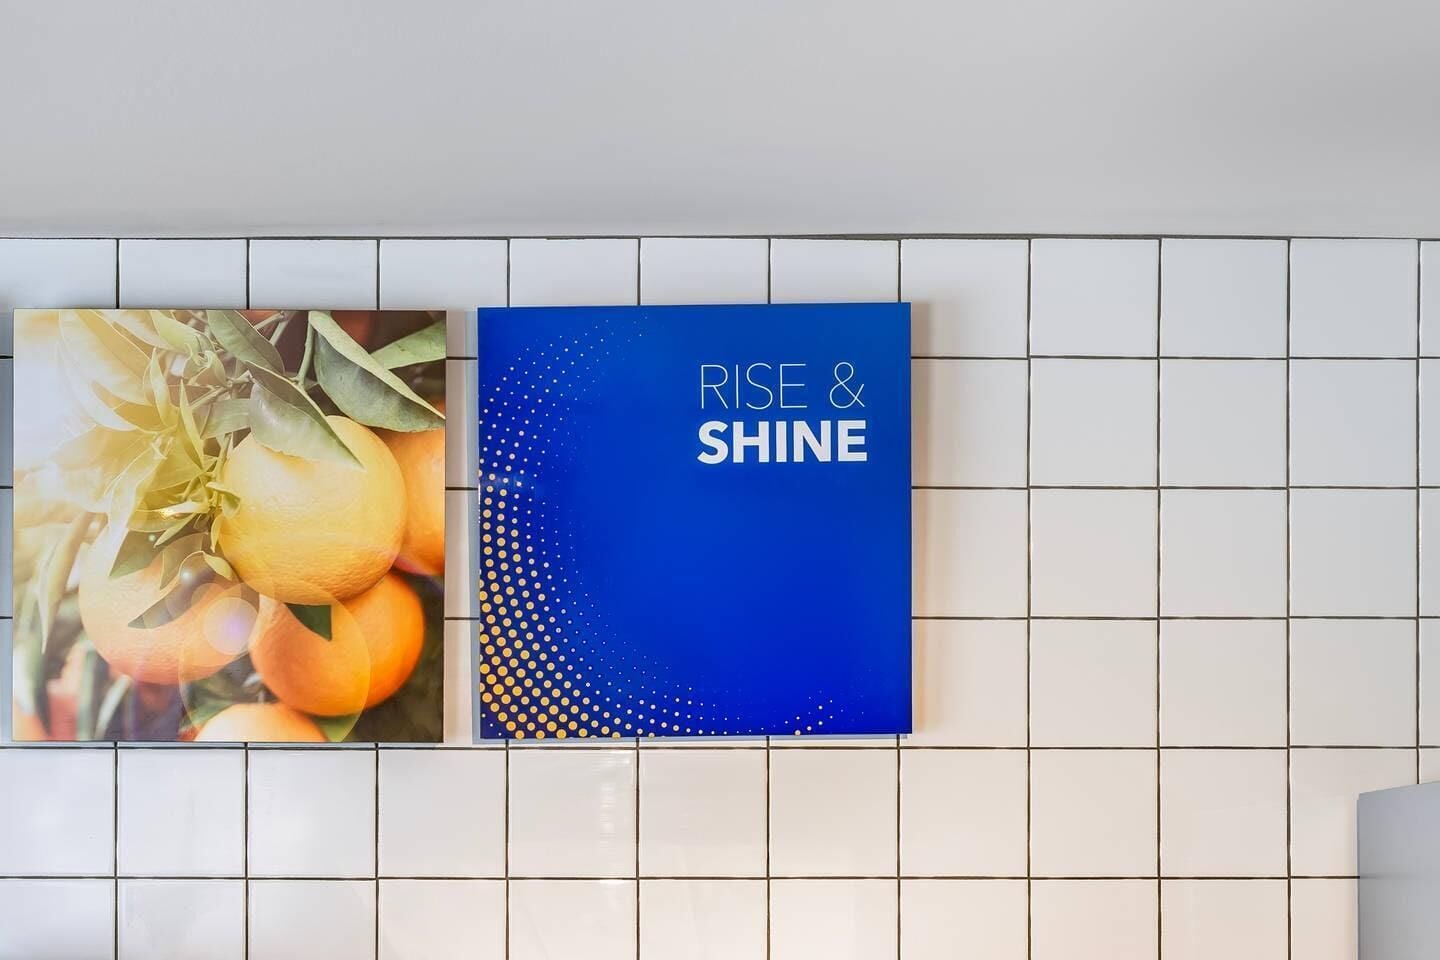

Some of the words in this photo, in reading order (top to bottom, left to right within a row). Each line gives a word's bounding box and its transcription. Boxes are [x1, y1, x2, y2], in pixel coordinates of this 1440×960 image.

[700, 362, 808, 410] RISE
[829, 361, 865, 409] &
[697, 419, 868, 465] SHINE
